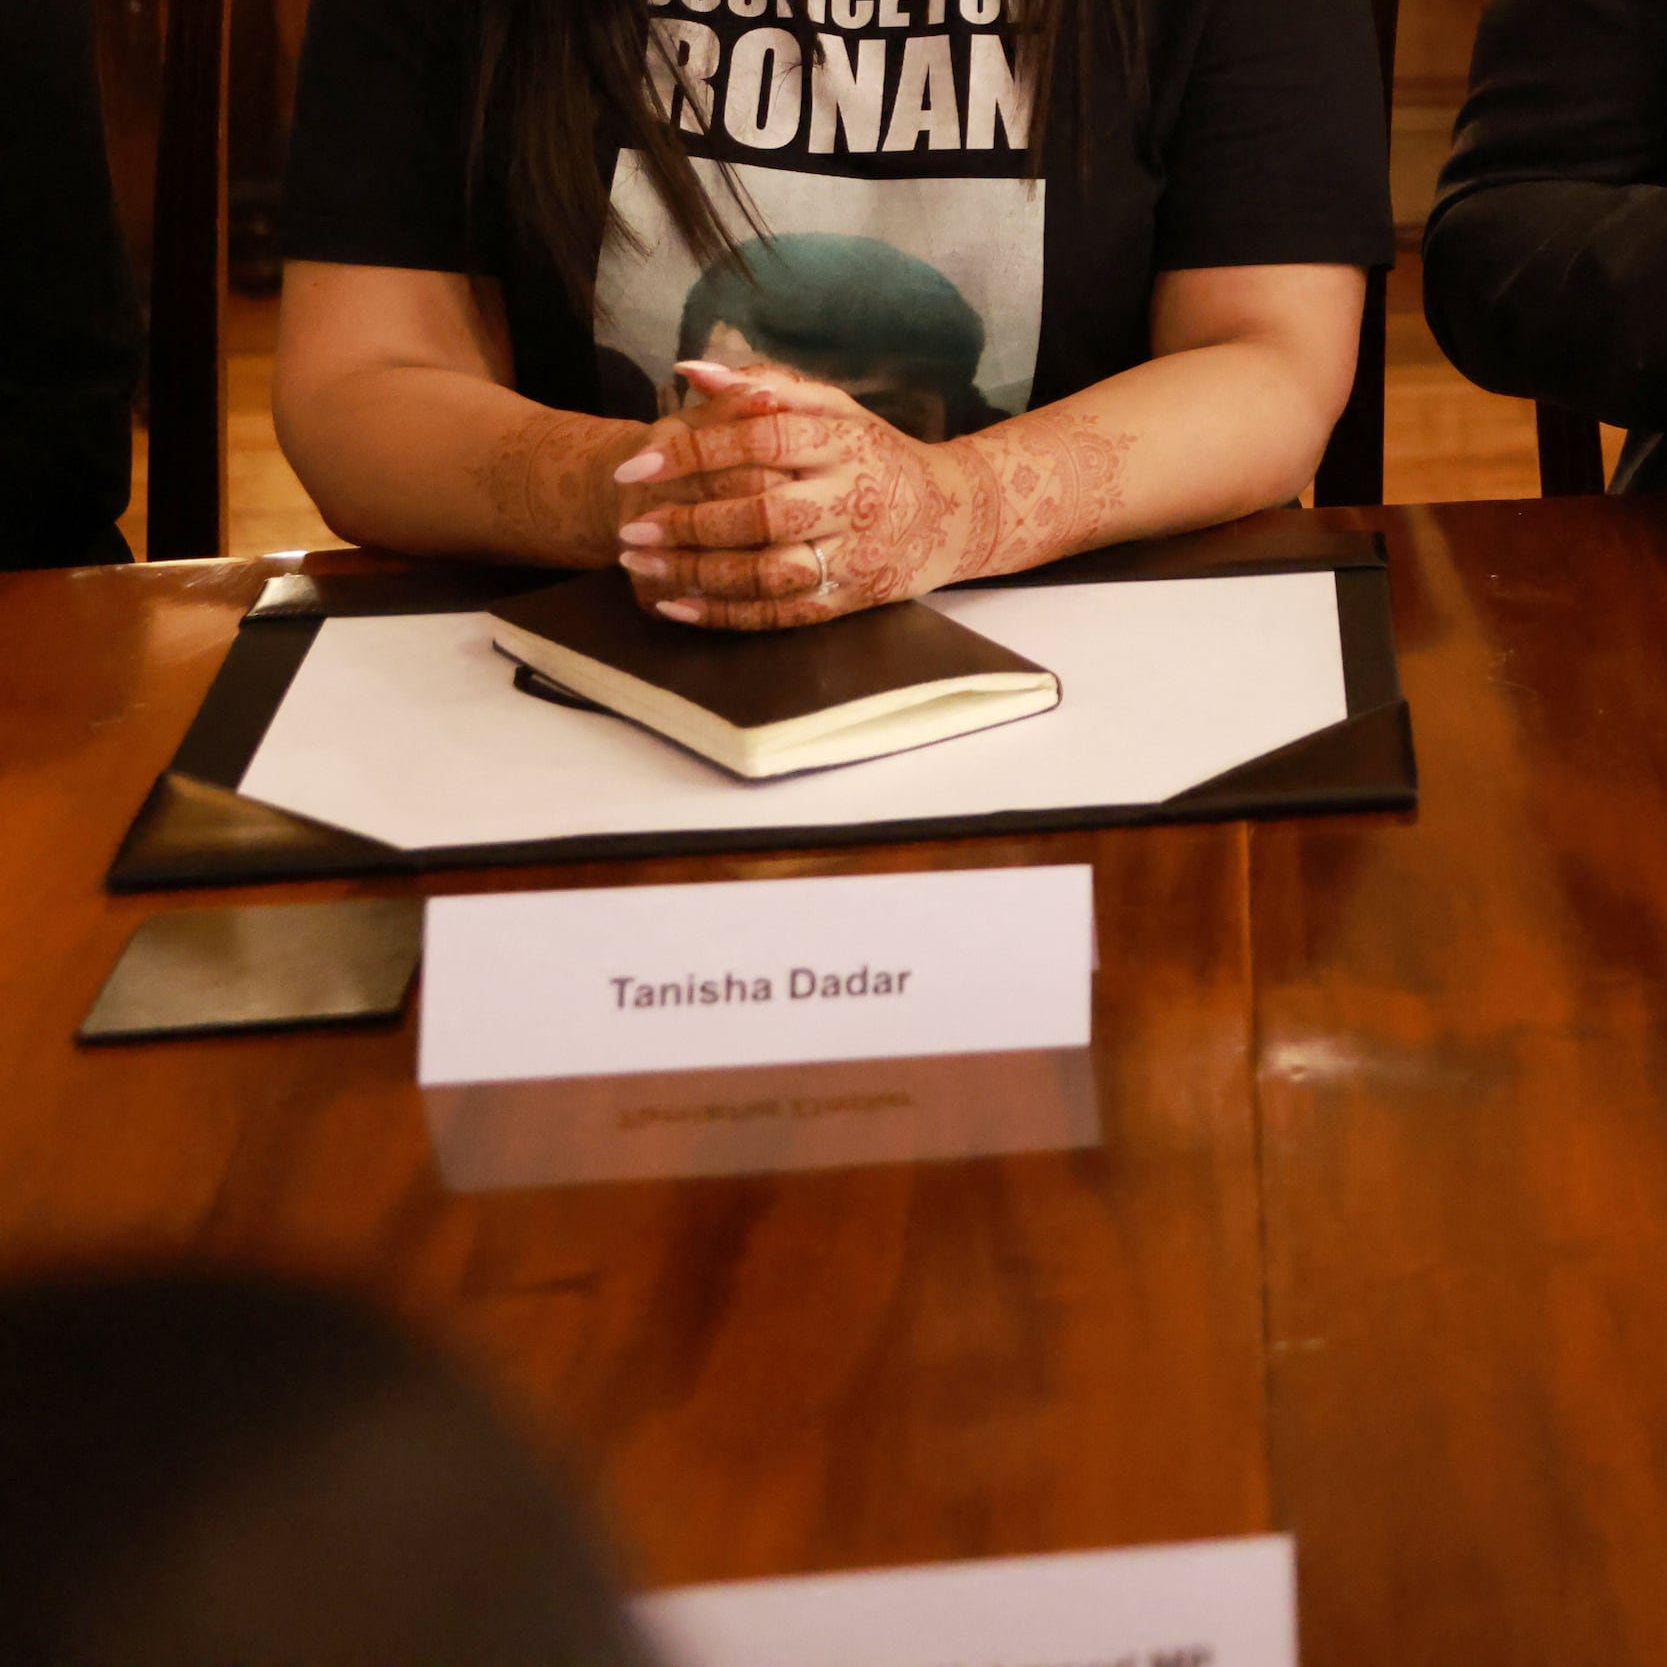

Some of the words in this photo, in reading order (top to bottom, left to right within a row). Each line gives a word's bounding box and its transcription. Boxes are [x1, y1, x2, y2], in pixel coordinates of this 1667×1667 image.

[644, 17, 1030, 154] RONAN
[609, 971, 773, 1011] Tanisha
[787, 964, 912, 1002] Dadar
